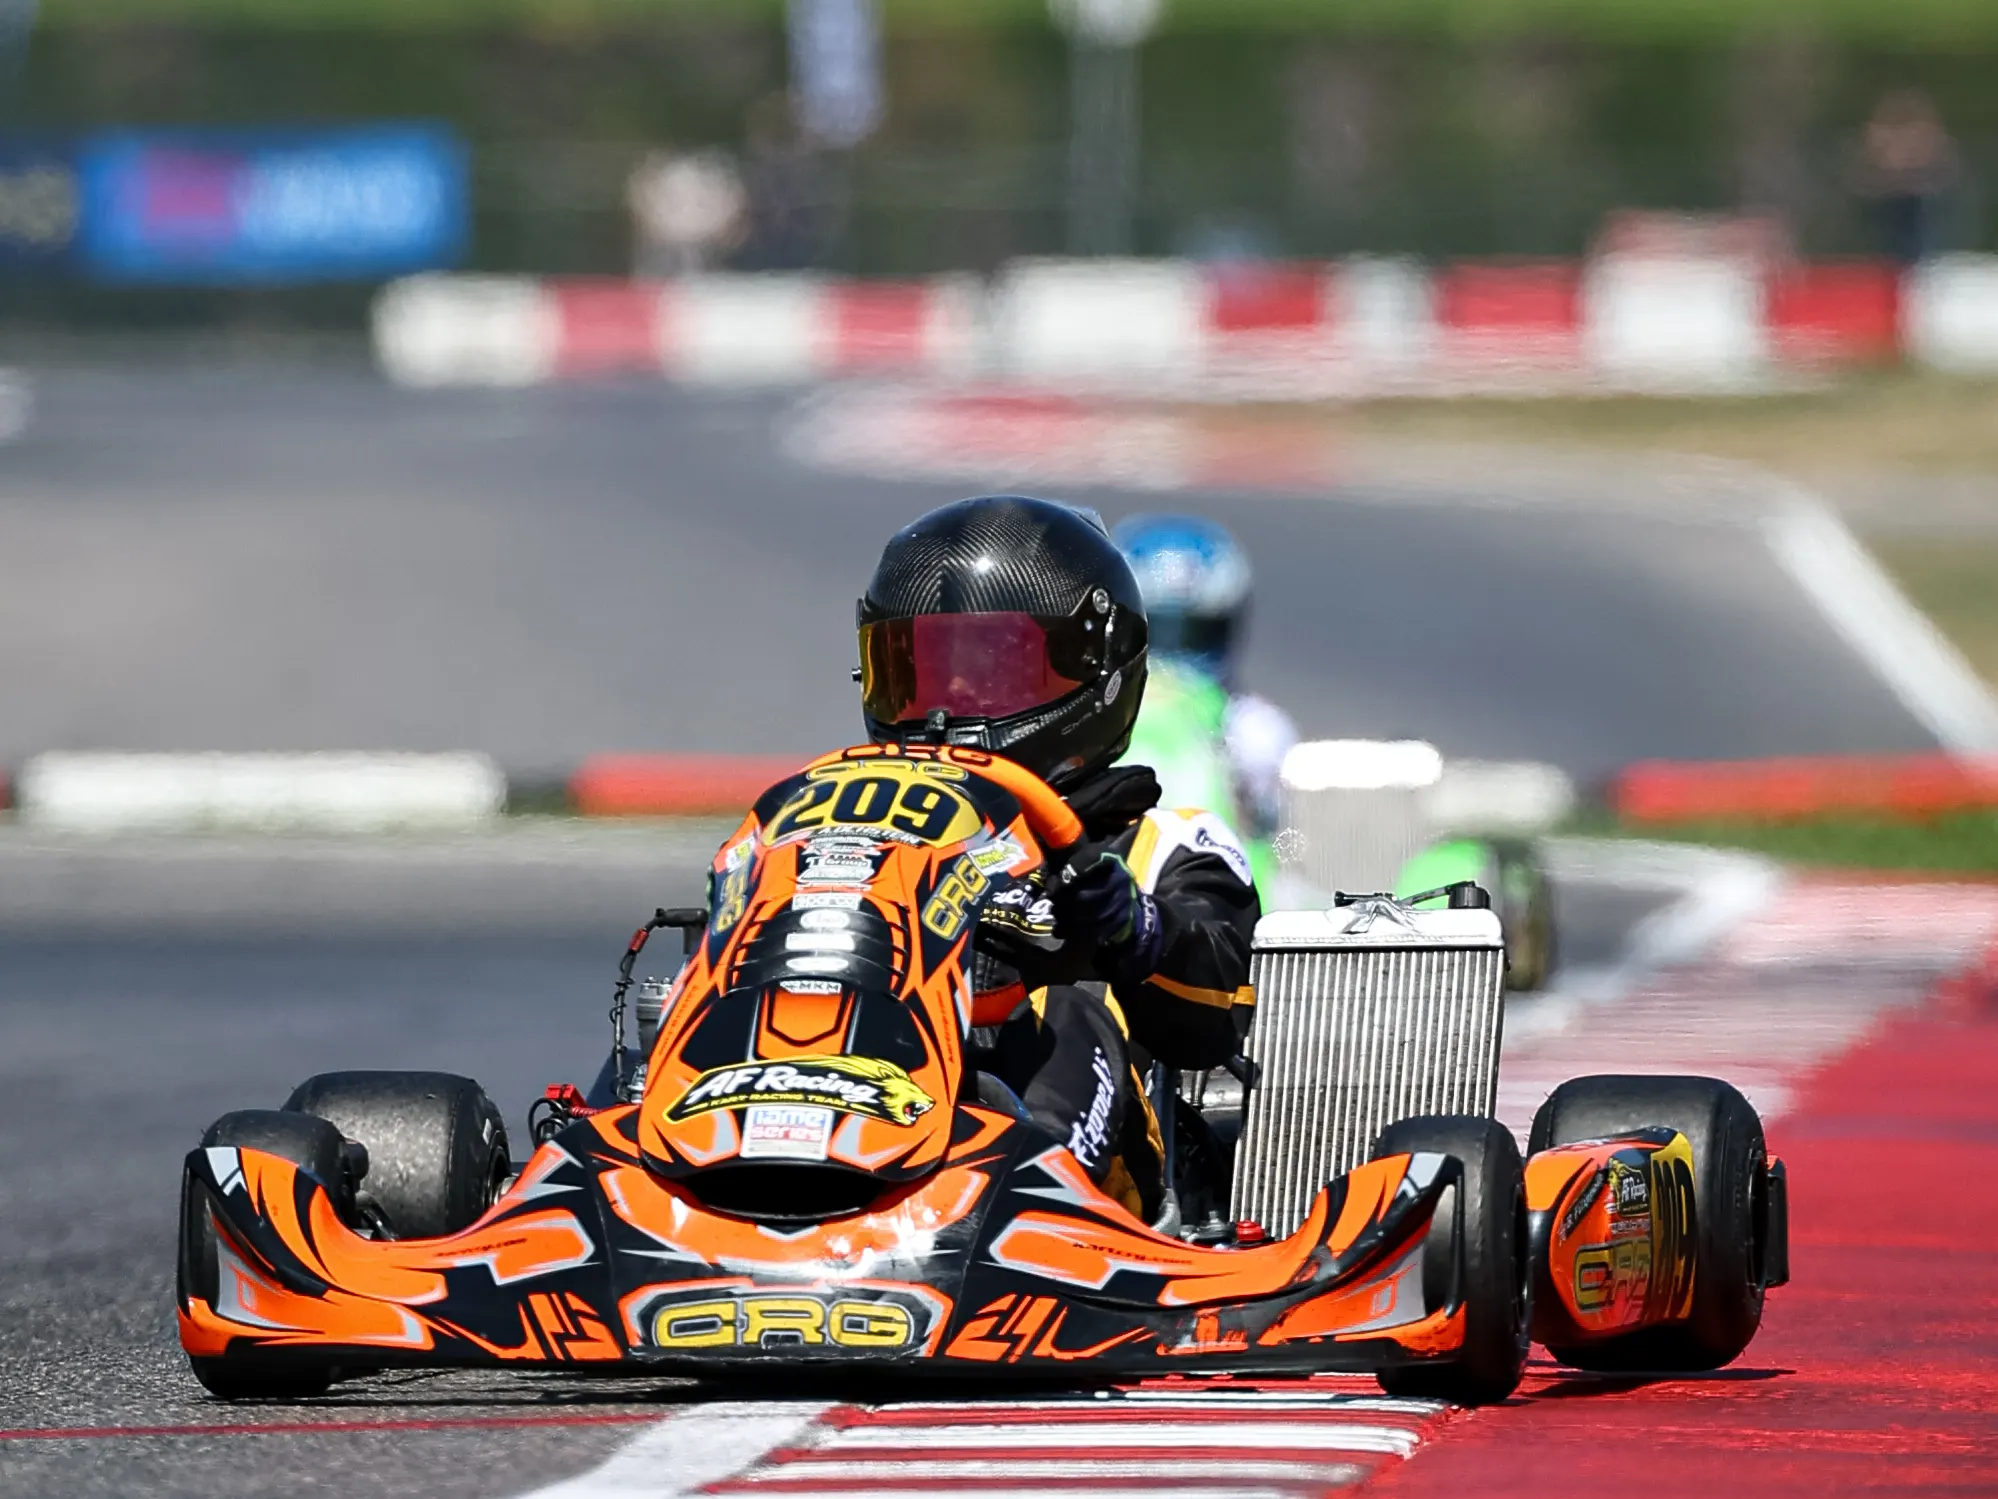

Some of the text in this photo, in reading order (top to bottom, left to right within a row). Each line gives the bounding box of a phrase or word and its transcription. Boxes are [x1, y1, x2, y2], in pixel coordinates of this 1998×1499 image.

[775, 776, 961, 842] 209
[922, 855, 990, 940] CRG
[685, 1066, 881, 1105] AF Racing
[710, 1092, 847, 1108] KART RACING TEAM
[752, 1126, 823, 1142] series
[653, 1297, 913, 1347] CRG
